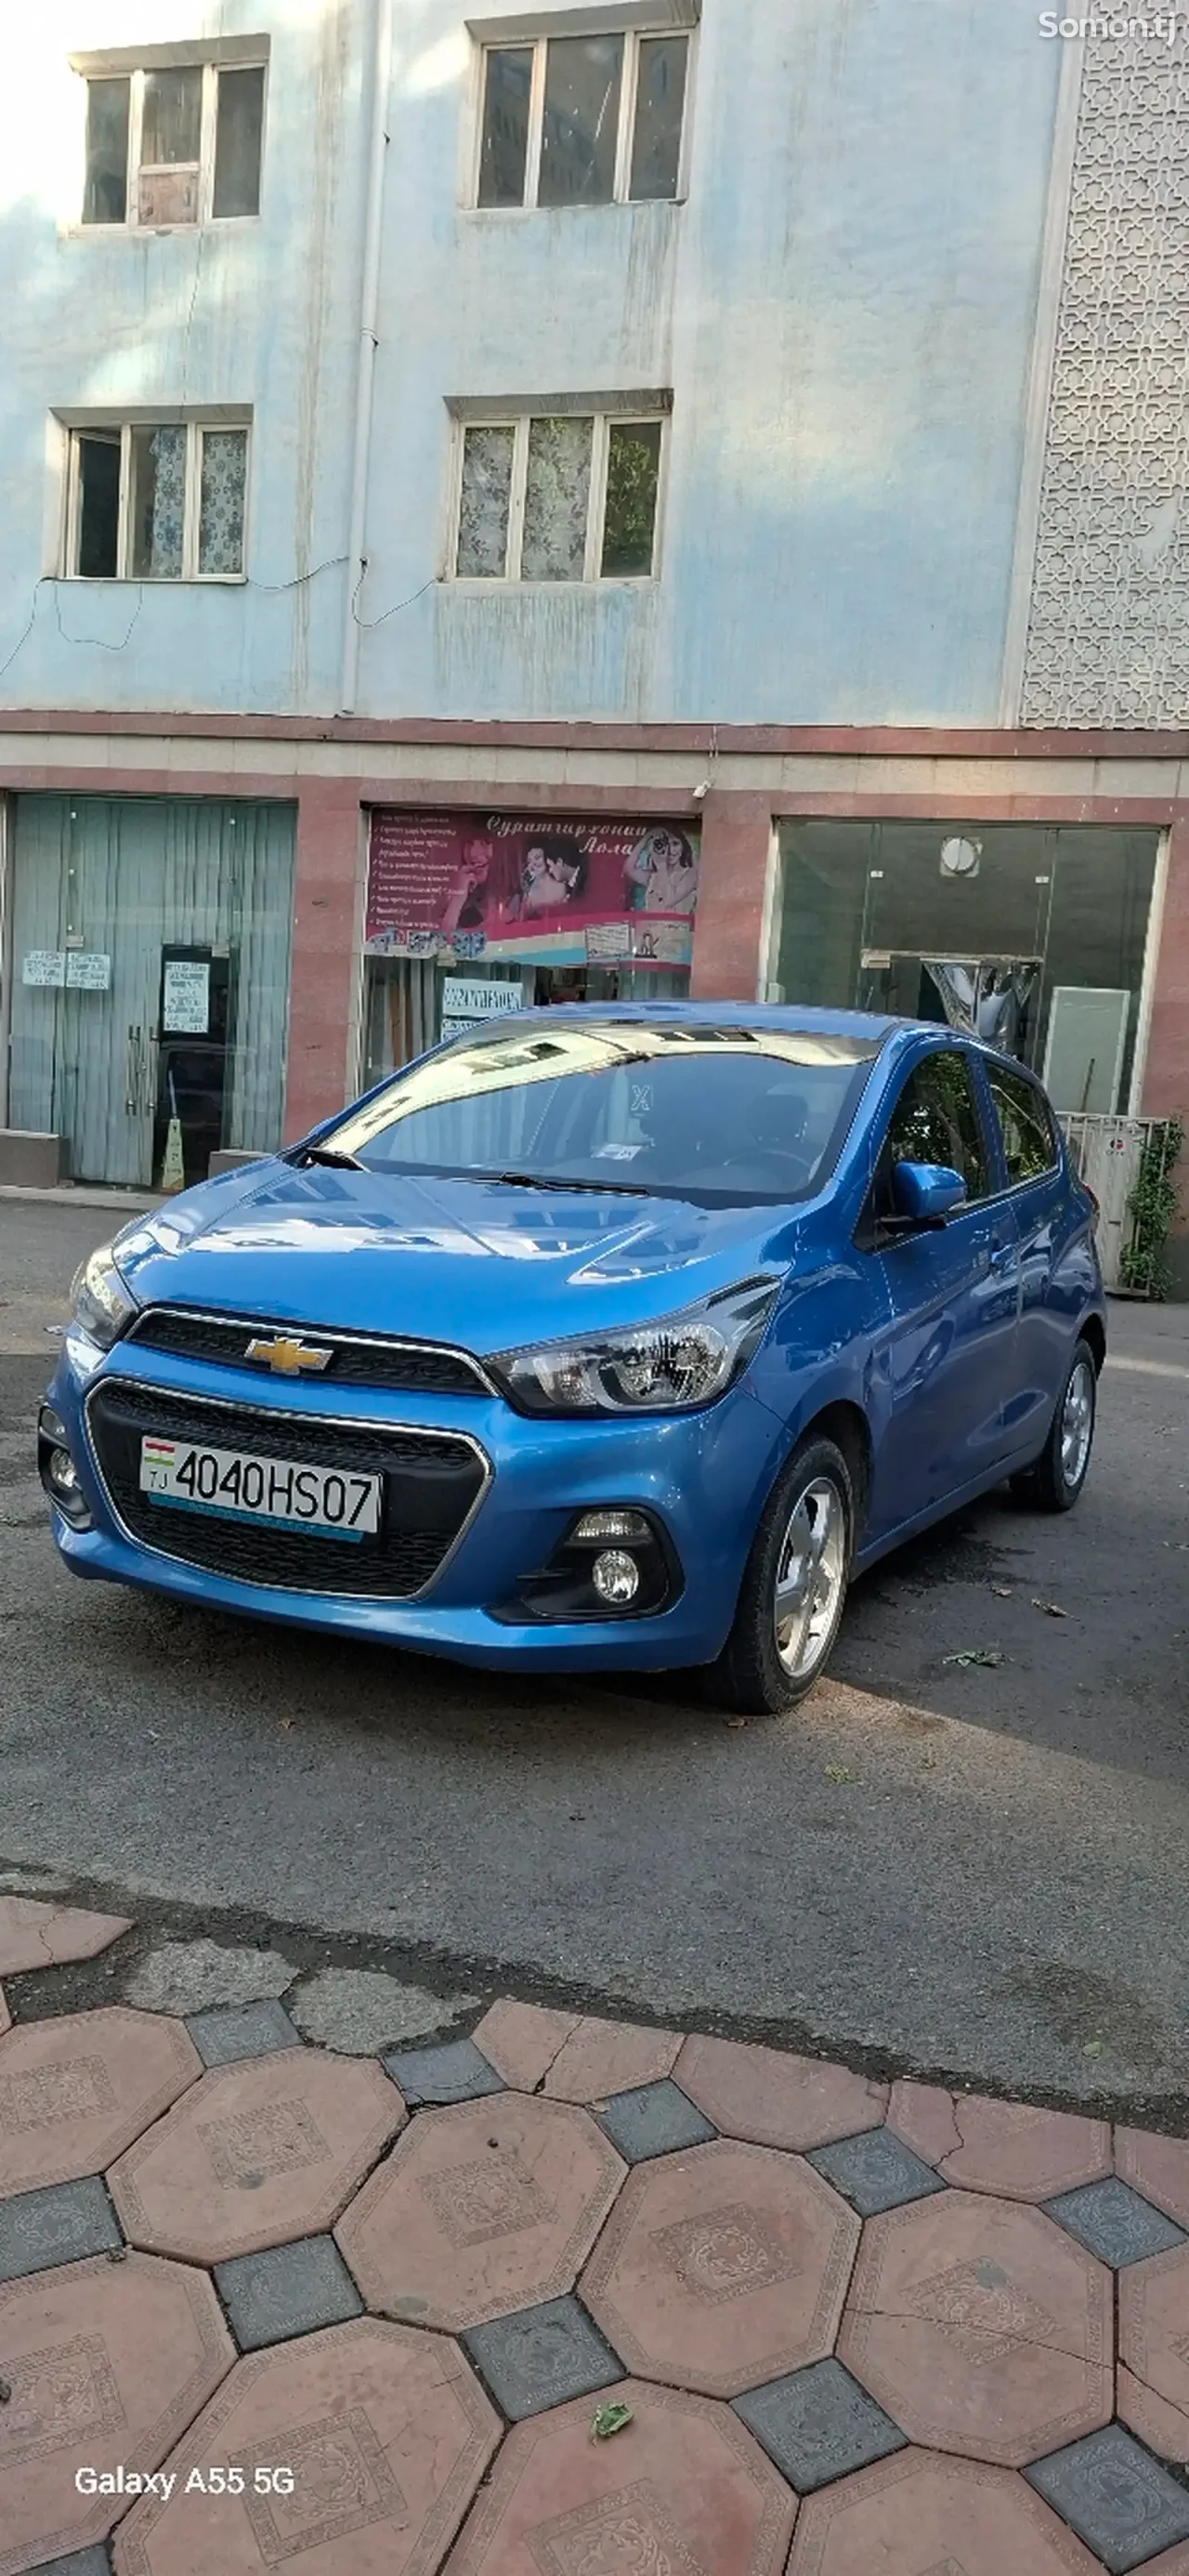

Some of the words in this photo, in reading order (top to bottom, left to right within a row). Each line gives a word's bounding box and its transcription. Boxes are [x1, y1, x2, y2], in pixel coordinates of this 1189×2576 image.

[579, 836, 634, 855] Лола
[150, 1471, 168, 1490] TJ
[176, 1450, 372, 1526] 4040HS07
